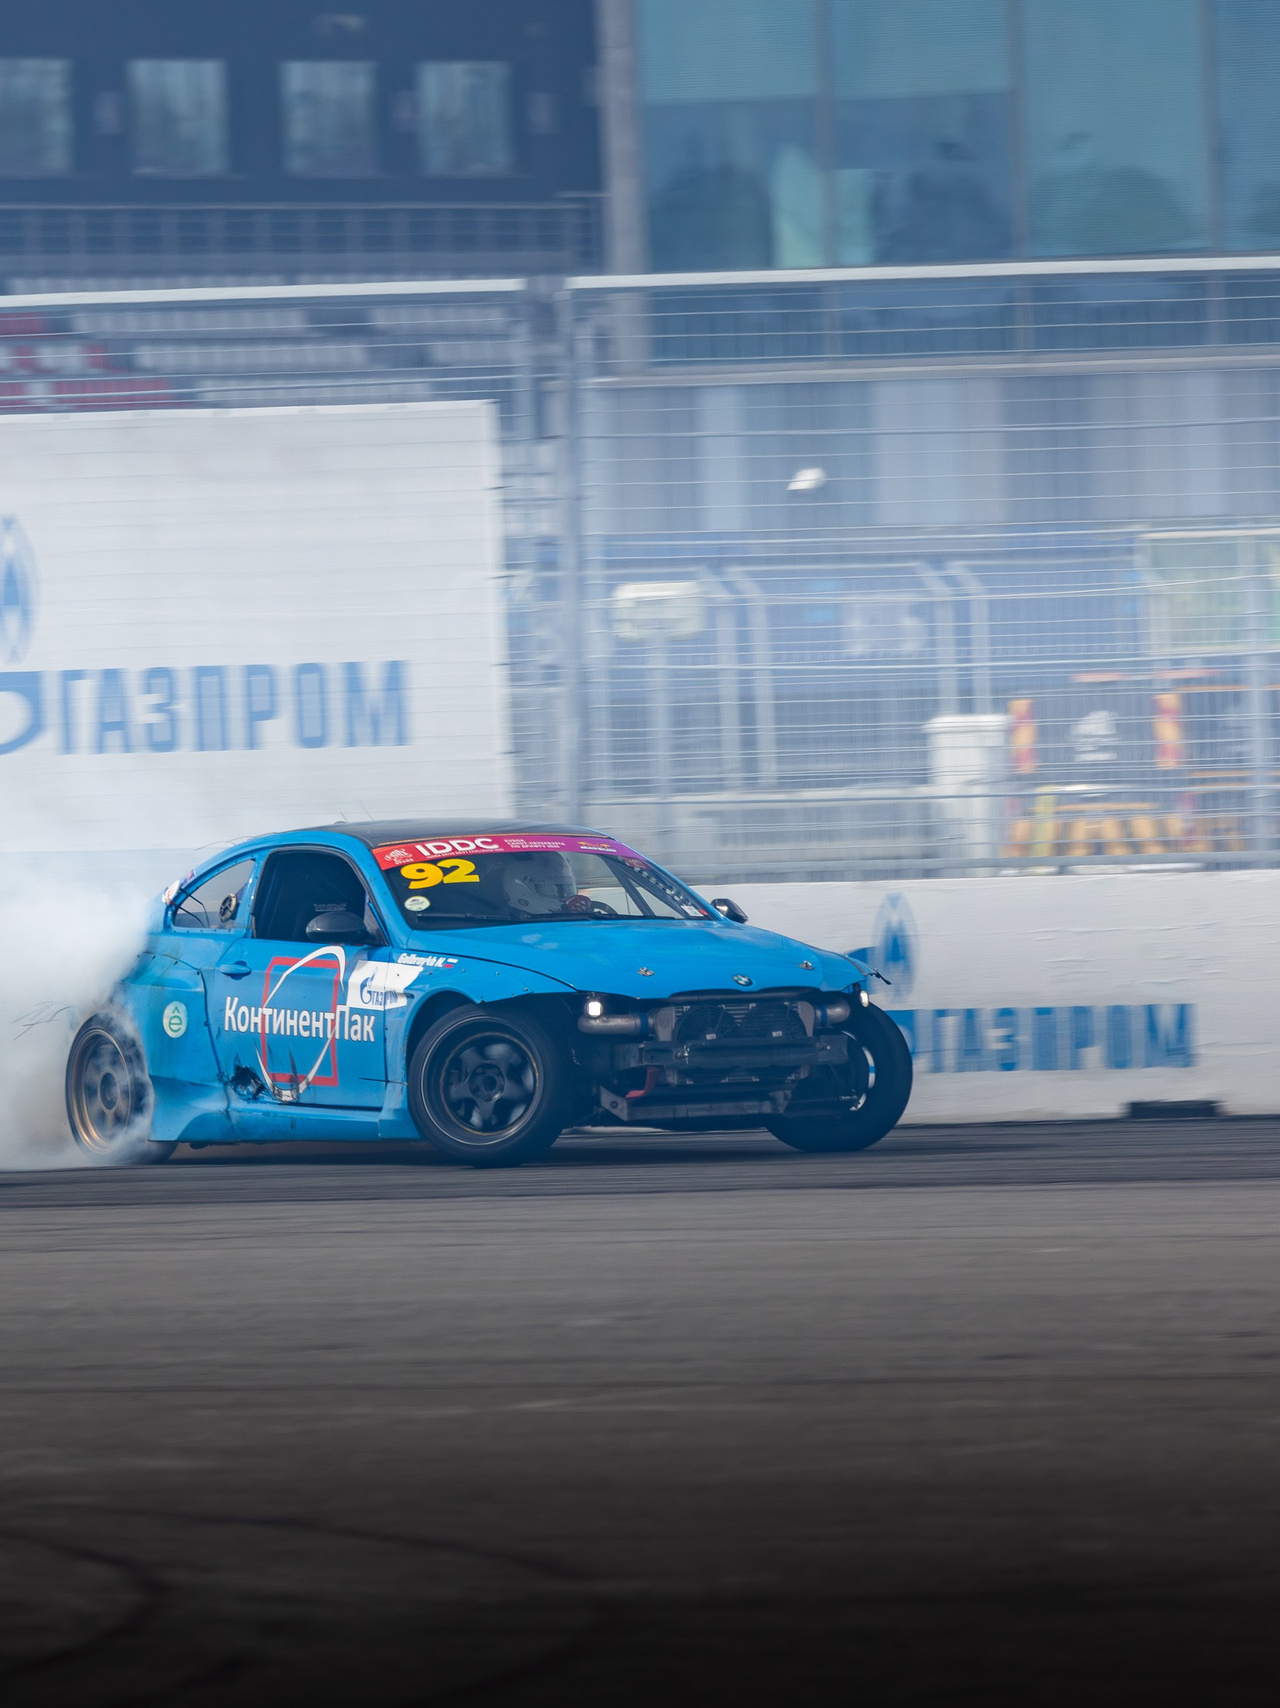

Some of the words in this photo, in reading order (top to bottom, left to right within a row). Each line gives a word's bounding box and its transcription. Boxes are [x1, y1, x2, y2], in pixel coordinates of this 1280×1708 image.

[58, 659, 412, 756] ГАЗПРОМ
[414, 837, 500, 857] IDDC
[400, 858, 480, 890] 92
[223, 996, 376, 1043] КонтинентПак
